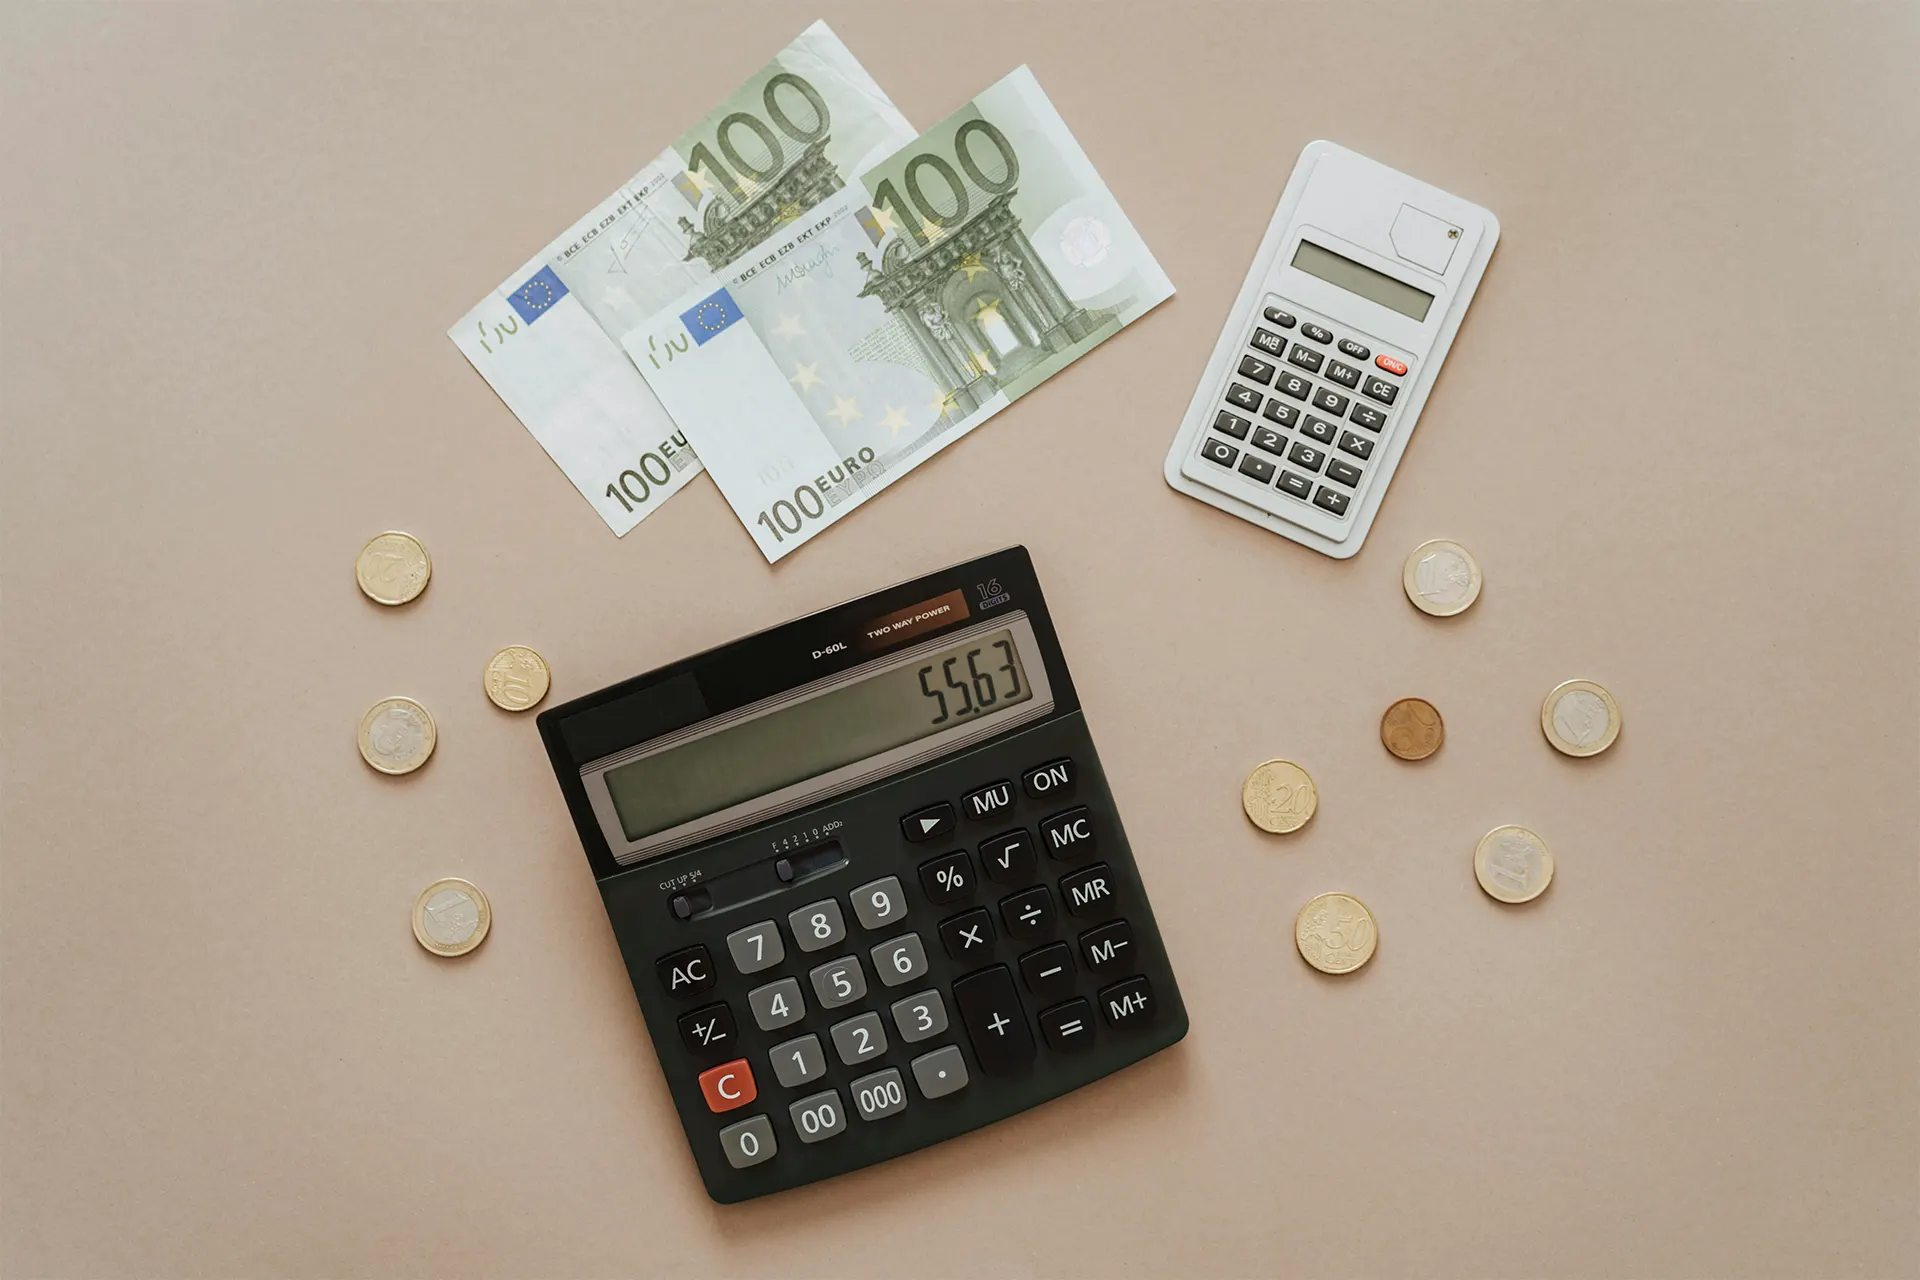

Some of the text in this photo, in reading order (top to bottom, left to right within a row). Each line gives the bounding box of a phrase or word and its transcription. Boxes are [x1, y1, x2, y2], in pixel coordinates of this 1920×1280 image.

[688, 73, 830, 204] 100
[872, 119, 1020, 248] 100
[563, 242, 581, 258] BCE
[581, 228, 599, 244] ECB
[599, 214, 616, 229] EZB
[617, 200, 633, 215] EKT
[633, 186, 649, 202] EKP
[739, 266, 758, 282] BCE
[758, 254, 777, 269] ECB
[777, 242, 795, 256] EZB
[796, 228, 814, 244] EKT
[814, 216, 832, 231] EKP
[1346, 342, 1365, 356] OFF
[1252, 362, 1265, 374] 7
[1333, 365, 1353, 380] M+
[1238, 391, 1252, 403] 4
[1287, 378, 1302, 392] 8
[1372, 382, 1392, 397] CE
[1275, 405, 1289, 419] 5
[1325, 394, 1339, 407] 9
[1228, 418, 1237, 430] 1
[1313, 422, 1326, 435] 6
[1263, 433, 1277, 448] 2
[1301, 449, 1315, 463] 3
[606, 452, 671, 513] 100
[757, 446, 875, 543] 100 EURO
[976, 578, 1002, 600] 16
[981, 594, 1009, 608] DIGITS
[867, 604, 951, 639] TWO WAY POWER
[812, 642, 848, 660] D-60L
[918, 639, 1021, 725] 55.63
[1033, 765, 1069, 791] ON
[972, 785, 1009, 814] MU
[1269, 783, 1310, 815] 20
[792, 834, 799, 843] 2
[1050, 818, 1090, 848] MC
[659, 869, 702, 891] CUT UP 5/4
[936, 865, 964, 892] %
[871, 891, 892, 917] 9
[1071, 878, 1110, 906] MR
[810, 913, 832, 939] 8
[746, 934, 764, 962] 7
[892, 947, 913, 974] 6
[671, 959, 707, 990] AC
[831, 970, 852, 998] 5
[770, 992, 790, 1018] 4
[912, 1005, 934, 1031] 3
[1109, 991, 1147, 1020] M+
[852, 1028, 874, 1055] 2
[791, 1051, 807, 1075] 1
[717, 1074, 741, 1099] C
[860, 1080, 902, 1113] 000
[801, 1103, 837, 1134] 00
[740, 1132, 760, 1157] 0
